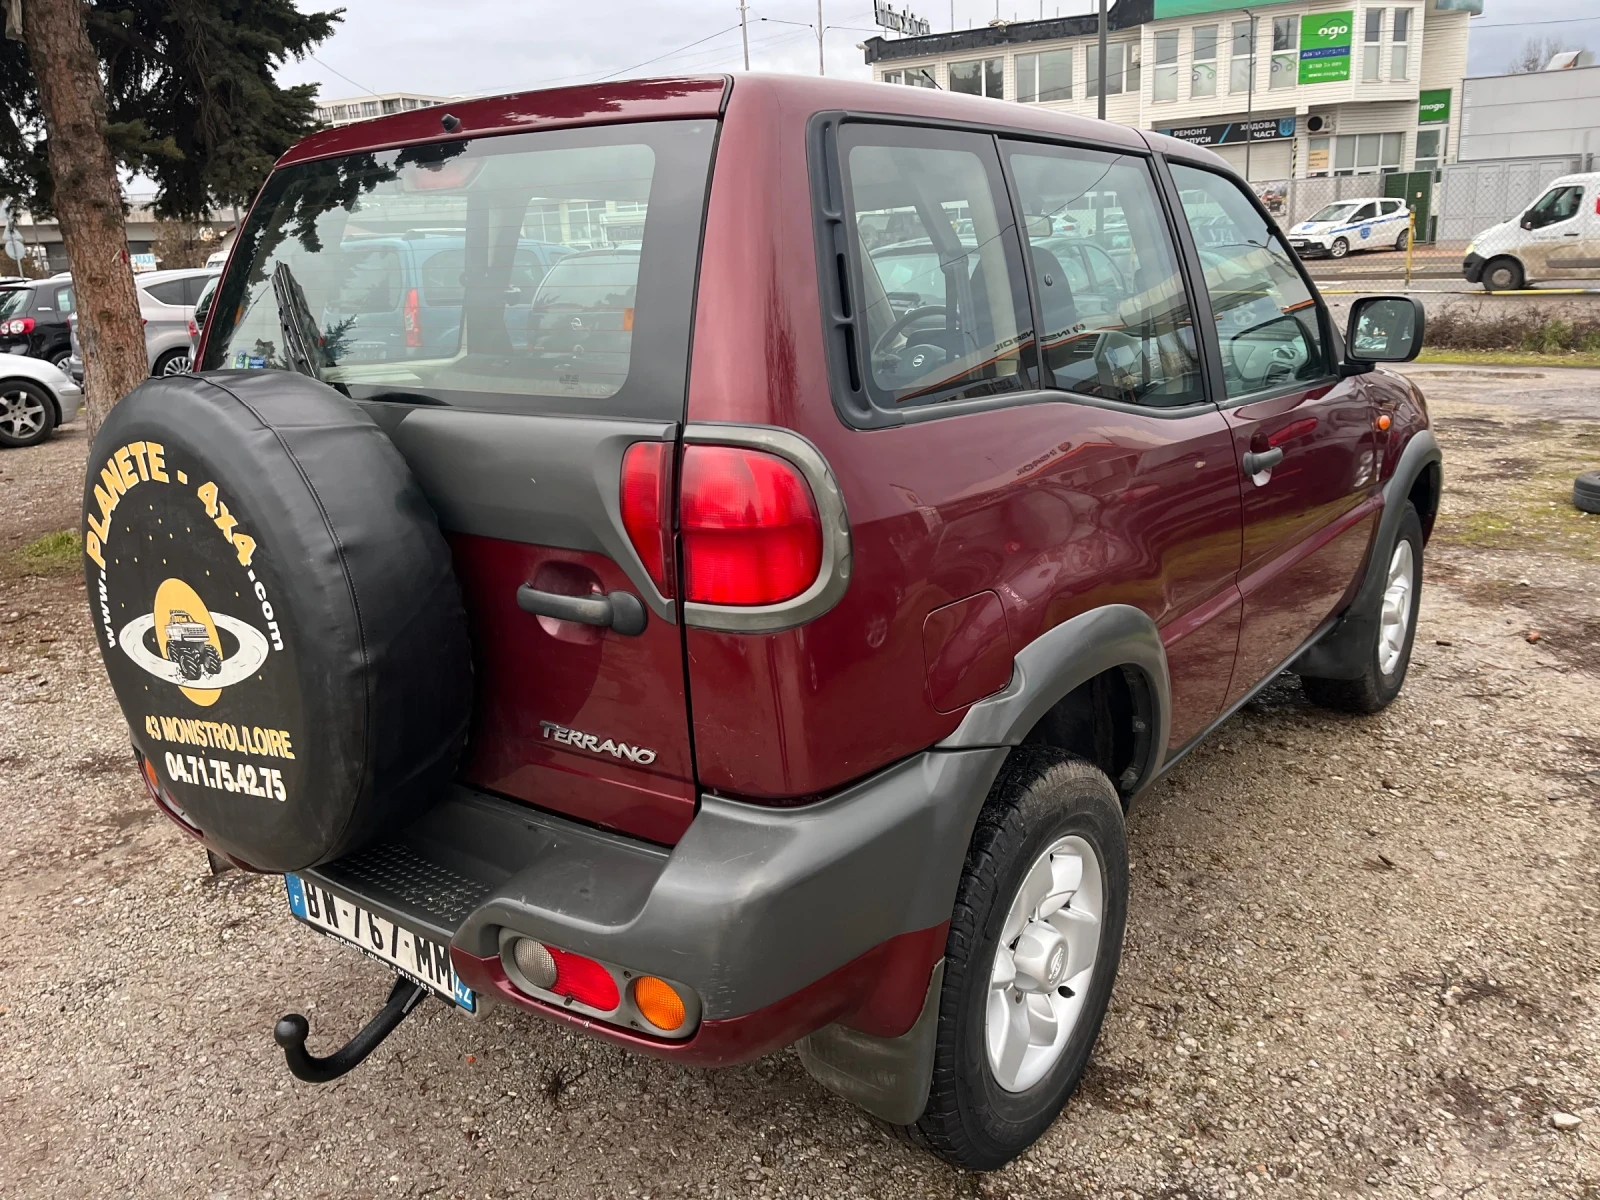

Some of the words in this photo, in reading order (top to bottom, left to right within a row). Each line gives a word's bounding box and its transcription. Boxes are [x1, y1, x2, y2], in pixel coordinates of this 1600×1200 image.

[1420, 103, 1445, 112] mogo
[1173, 128, 1208, 137] РЕМОНТ
[1253, 130, 1276, 138] ЧАСТ
[144, 715, 162, 741] 43
[159, 715, 296, 760] MONISTROL/LOIRE
[539, 720, 658, 765] TERRANO
[164, 751, 288, 802] 04.71.75.42.75
[294, 894, 301, 907] F
